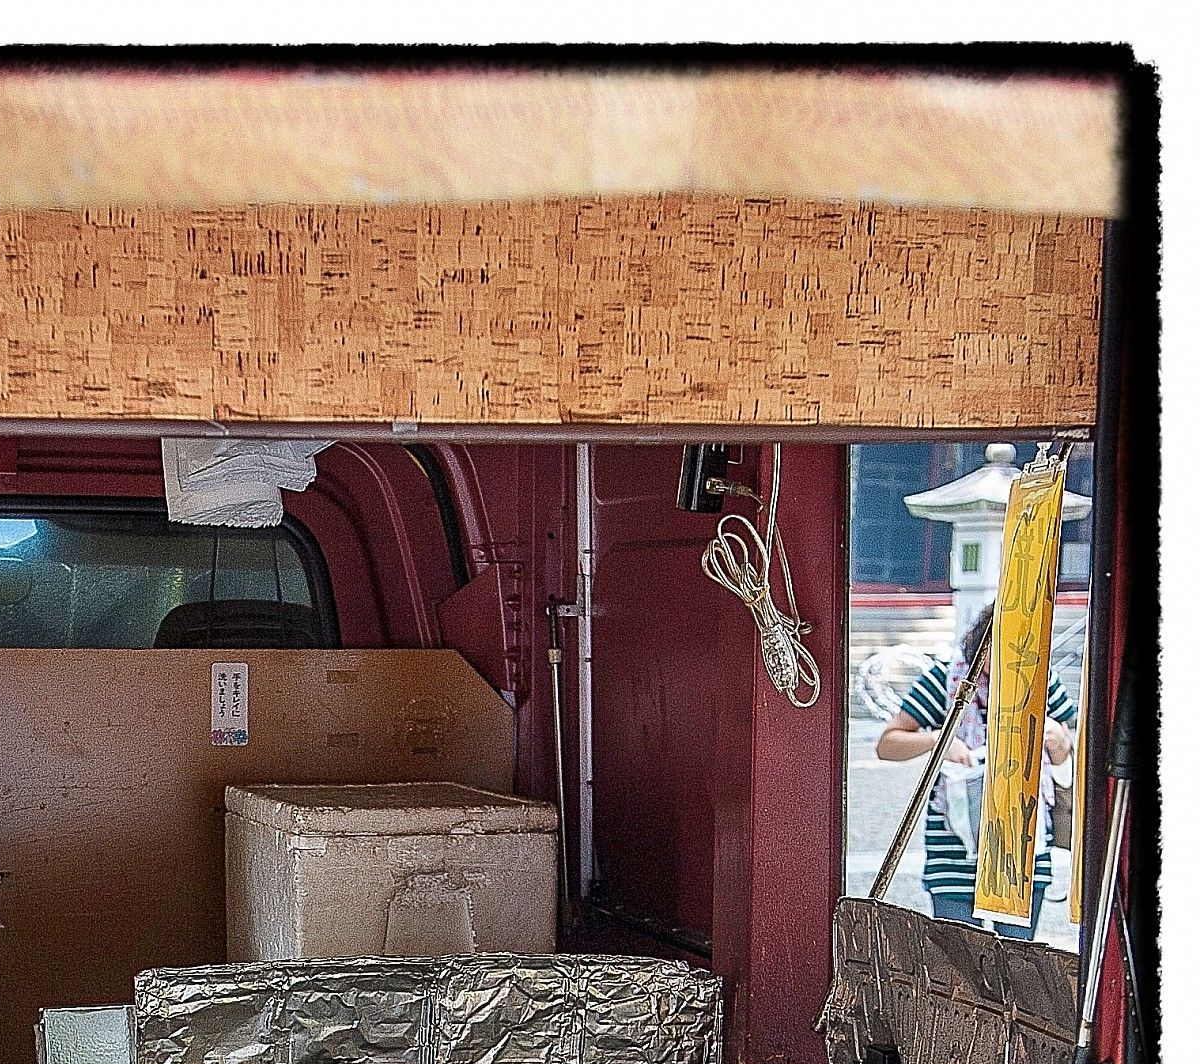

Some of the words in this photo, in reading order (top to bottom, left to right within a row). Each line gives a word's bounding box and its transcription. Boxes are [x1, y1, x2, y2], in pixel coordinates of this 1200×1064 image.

[217, 672, 228, 718] 洗いましょう
[231, 672, 241, 718] 手をキレイに
